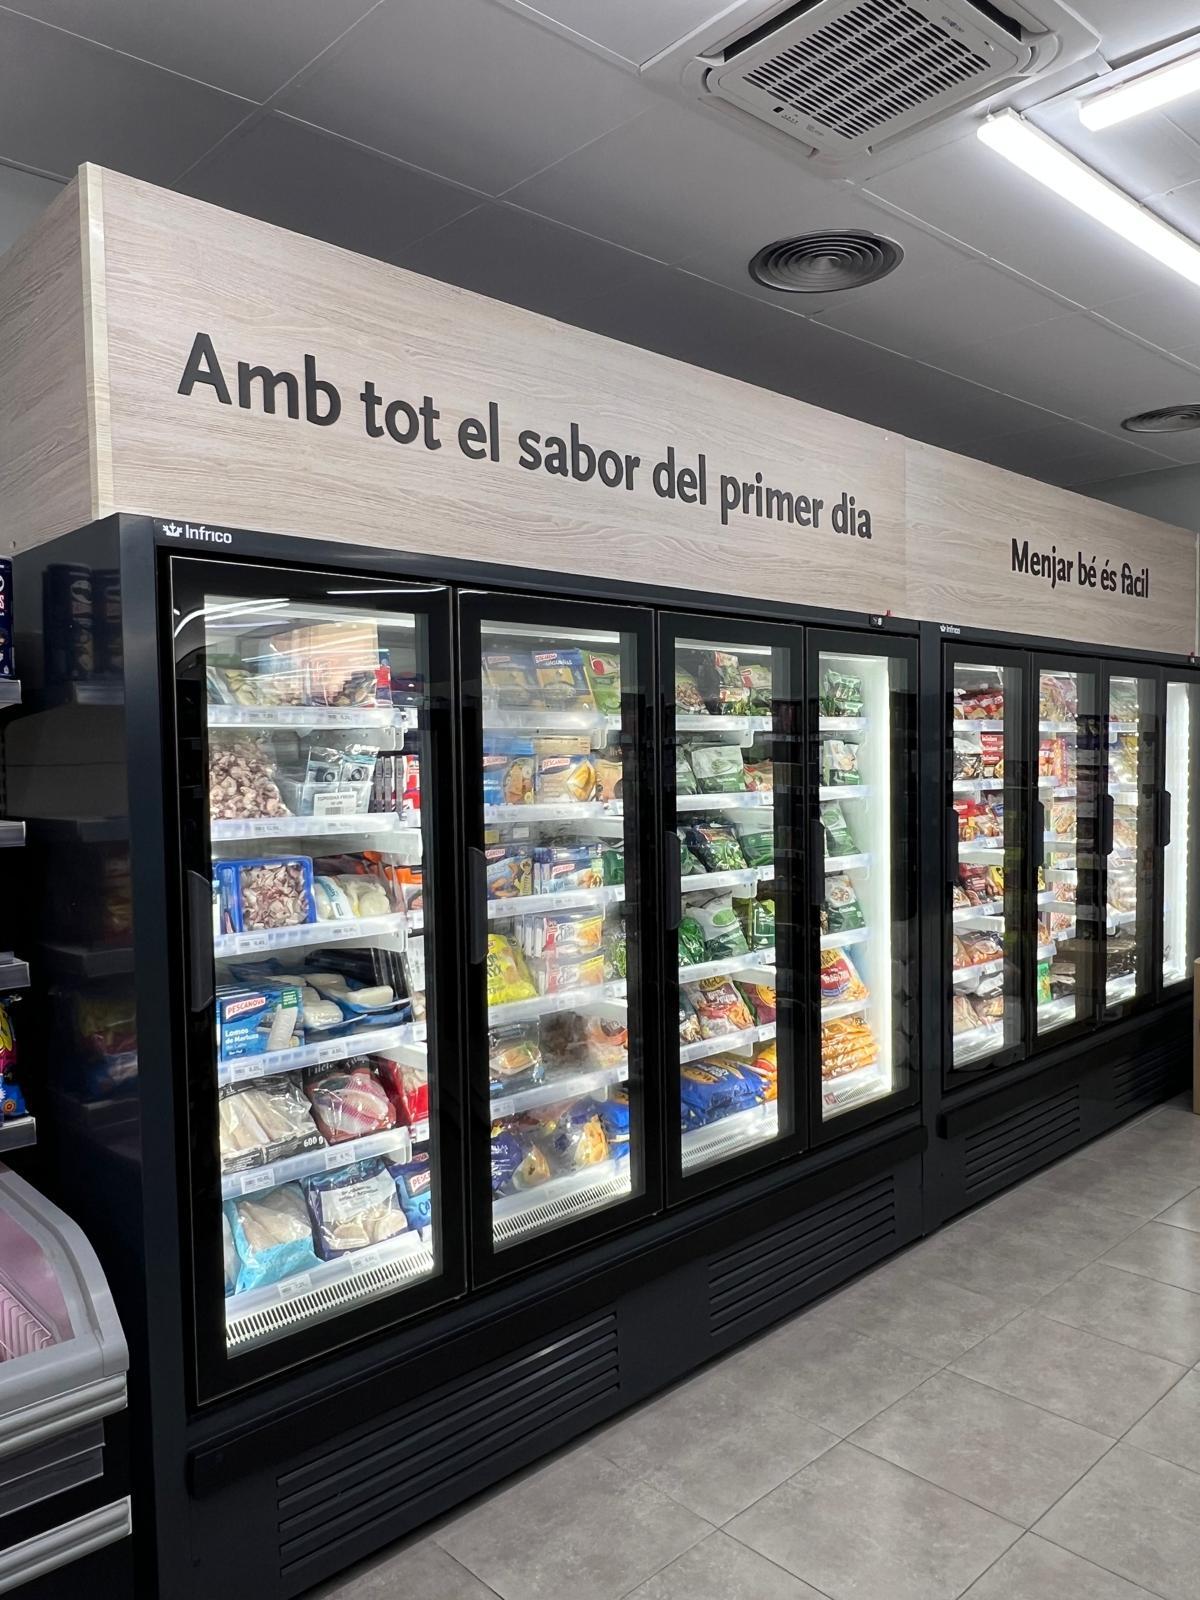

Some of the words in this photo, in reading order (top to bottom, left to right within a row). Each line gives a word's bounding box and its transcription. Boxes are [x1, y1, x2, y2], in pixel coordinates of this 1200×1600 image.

[177, 332, 342, 427] Amb
[360, 381, 442, 450] tot
[458, 401, 500, 462] el
[518, 422, 640, 490] sabor
[652, 446, 707, 505] del
[720, 471, 823, 526] primer
[831, 492, 872, 540] dia
[185, 524, 233, 545] Infrico
[1011, 538, 1074, 589] Menjar
[1078, 551, 1097, 588] bé
[1100, 560, 1117, 592] és
[226, 997, 266, 1018] PESCANOVA
[303, 1137, 318, 1148] 600
